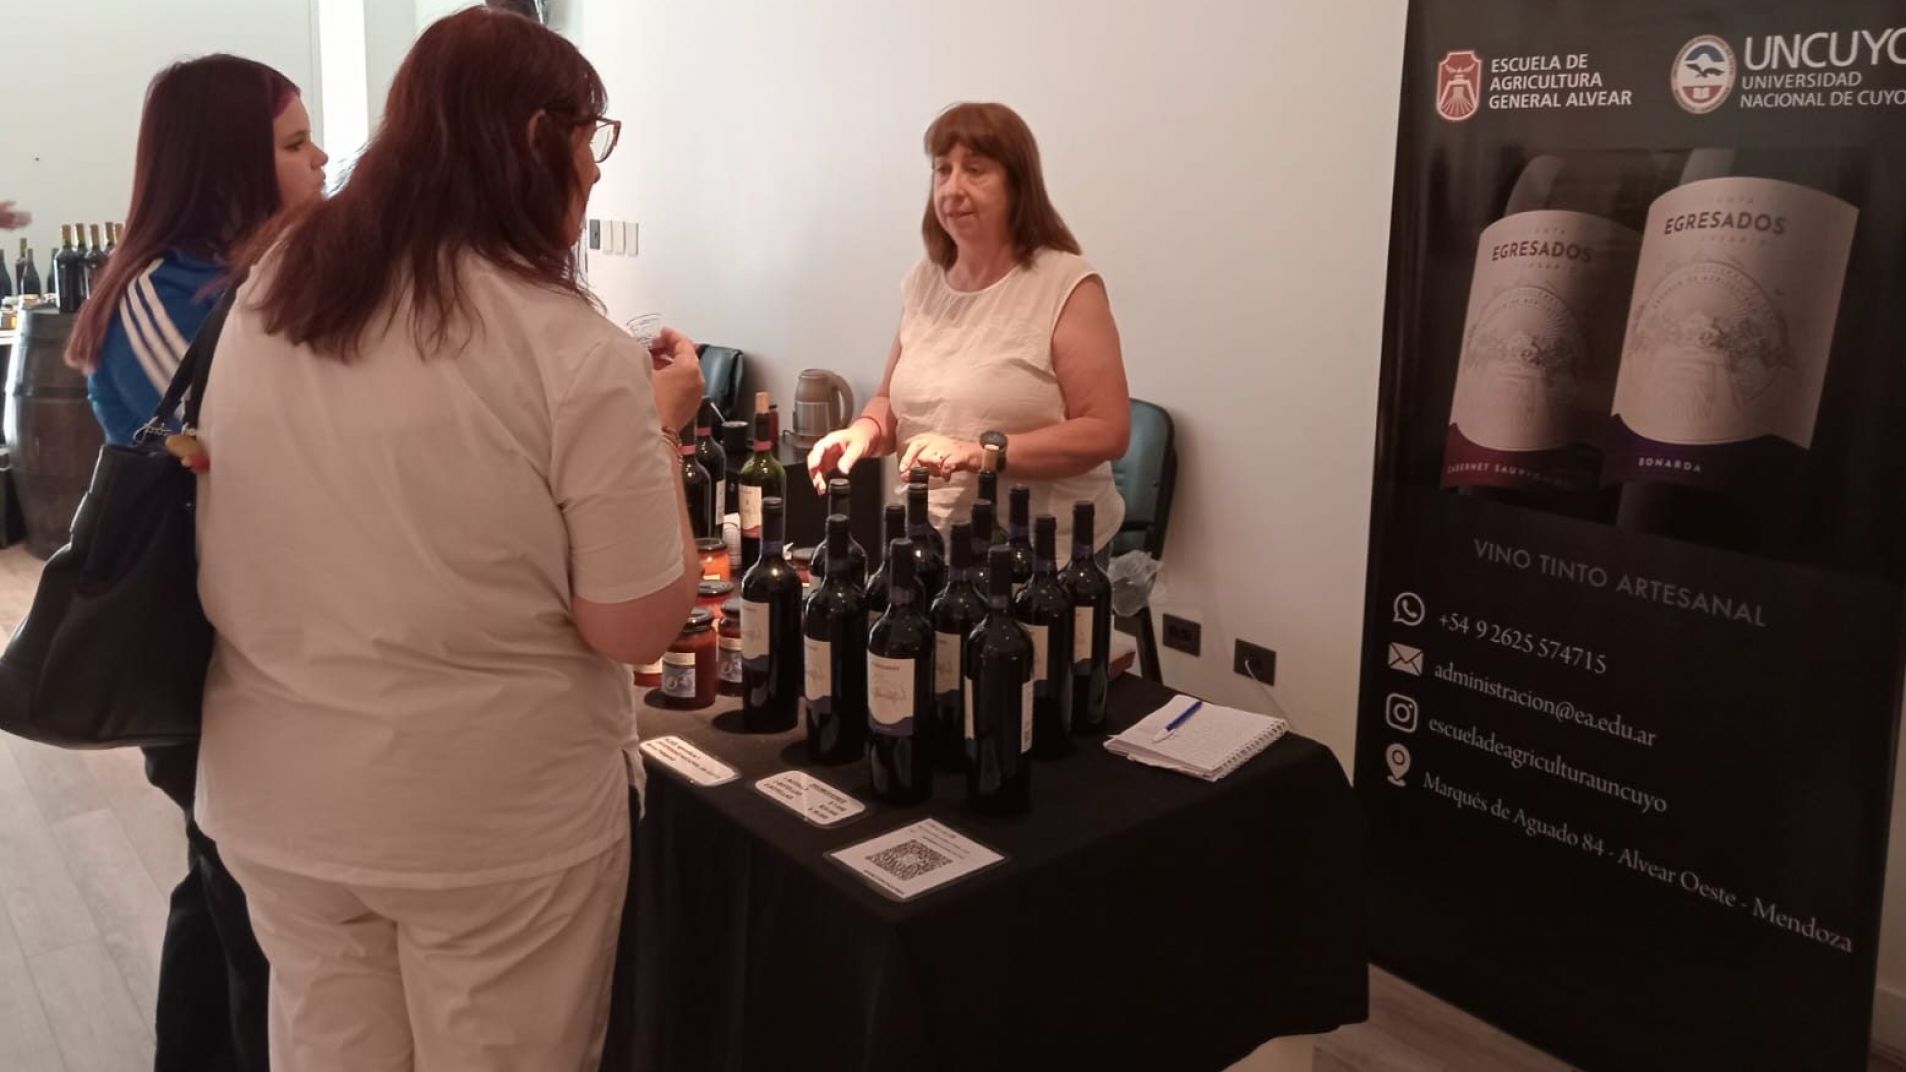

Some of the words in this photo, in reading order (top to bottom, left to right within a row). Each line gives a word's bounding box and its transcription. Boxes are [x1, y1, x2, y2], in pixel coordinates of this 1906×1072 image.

[1491, 55, 1561, 72] ESCUELA
[1567, 54, 1588, 69] DE
[1490, 72, 1603, 91] AGRICULTURA
[1742, 71, 1862, 90] UNIVERSIDAD
[1489, 93, 1561, 109] GENERAL
[1566, 90, 1632, 107] ALVEAR
[1740, 92, 1825, 108] NACIONAL
[1830, 91, 1853, 106] DE
[1857, 90, 1906, 105] CUYO
[1664, 211, 1787, 235] EGRESADOS
[1492, 240, 1594, 263] EGRESADOS
[1638, 457, 1702, 473] BONARDA
[1474, 538, 1531, 569] VINO
[1539, 554, 1608, 587] TINTO
[1616, 573, 1767, 628] ARTESANAL
[1439, 612, 1469, 635] +54
[1476, 620, 1487, 639] 9
[1490, 624, 1534, 653] 2625
[1537, 637, 1608, 674] 574715
[1434, 661, 1656, 747] administracion@ea.edu.ar
[1428, 718, 1668, 814] escueladeagriculturauncuyo
[1490, 798, 1511, 820] de
[1513, 808, 1579, 848] Aguado
[1582, 832, 1605, 857] 84
[1617, 848, 1676, 884] Alvear
[1680, 870, 1737, 908] Oeste
[1752, 897, 1853, 953] Mendoza
